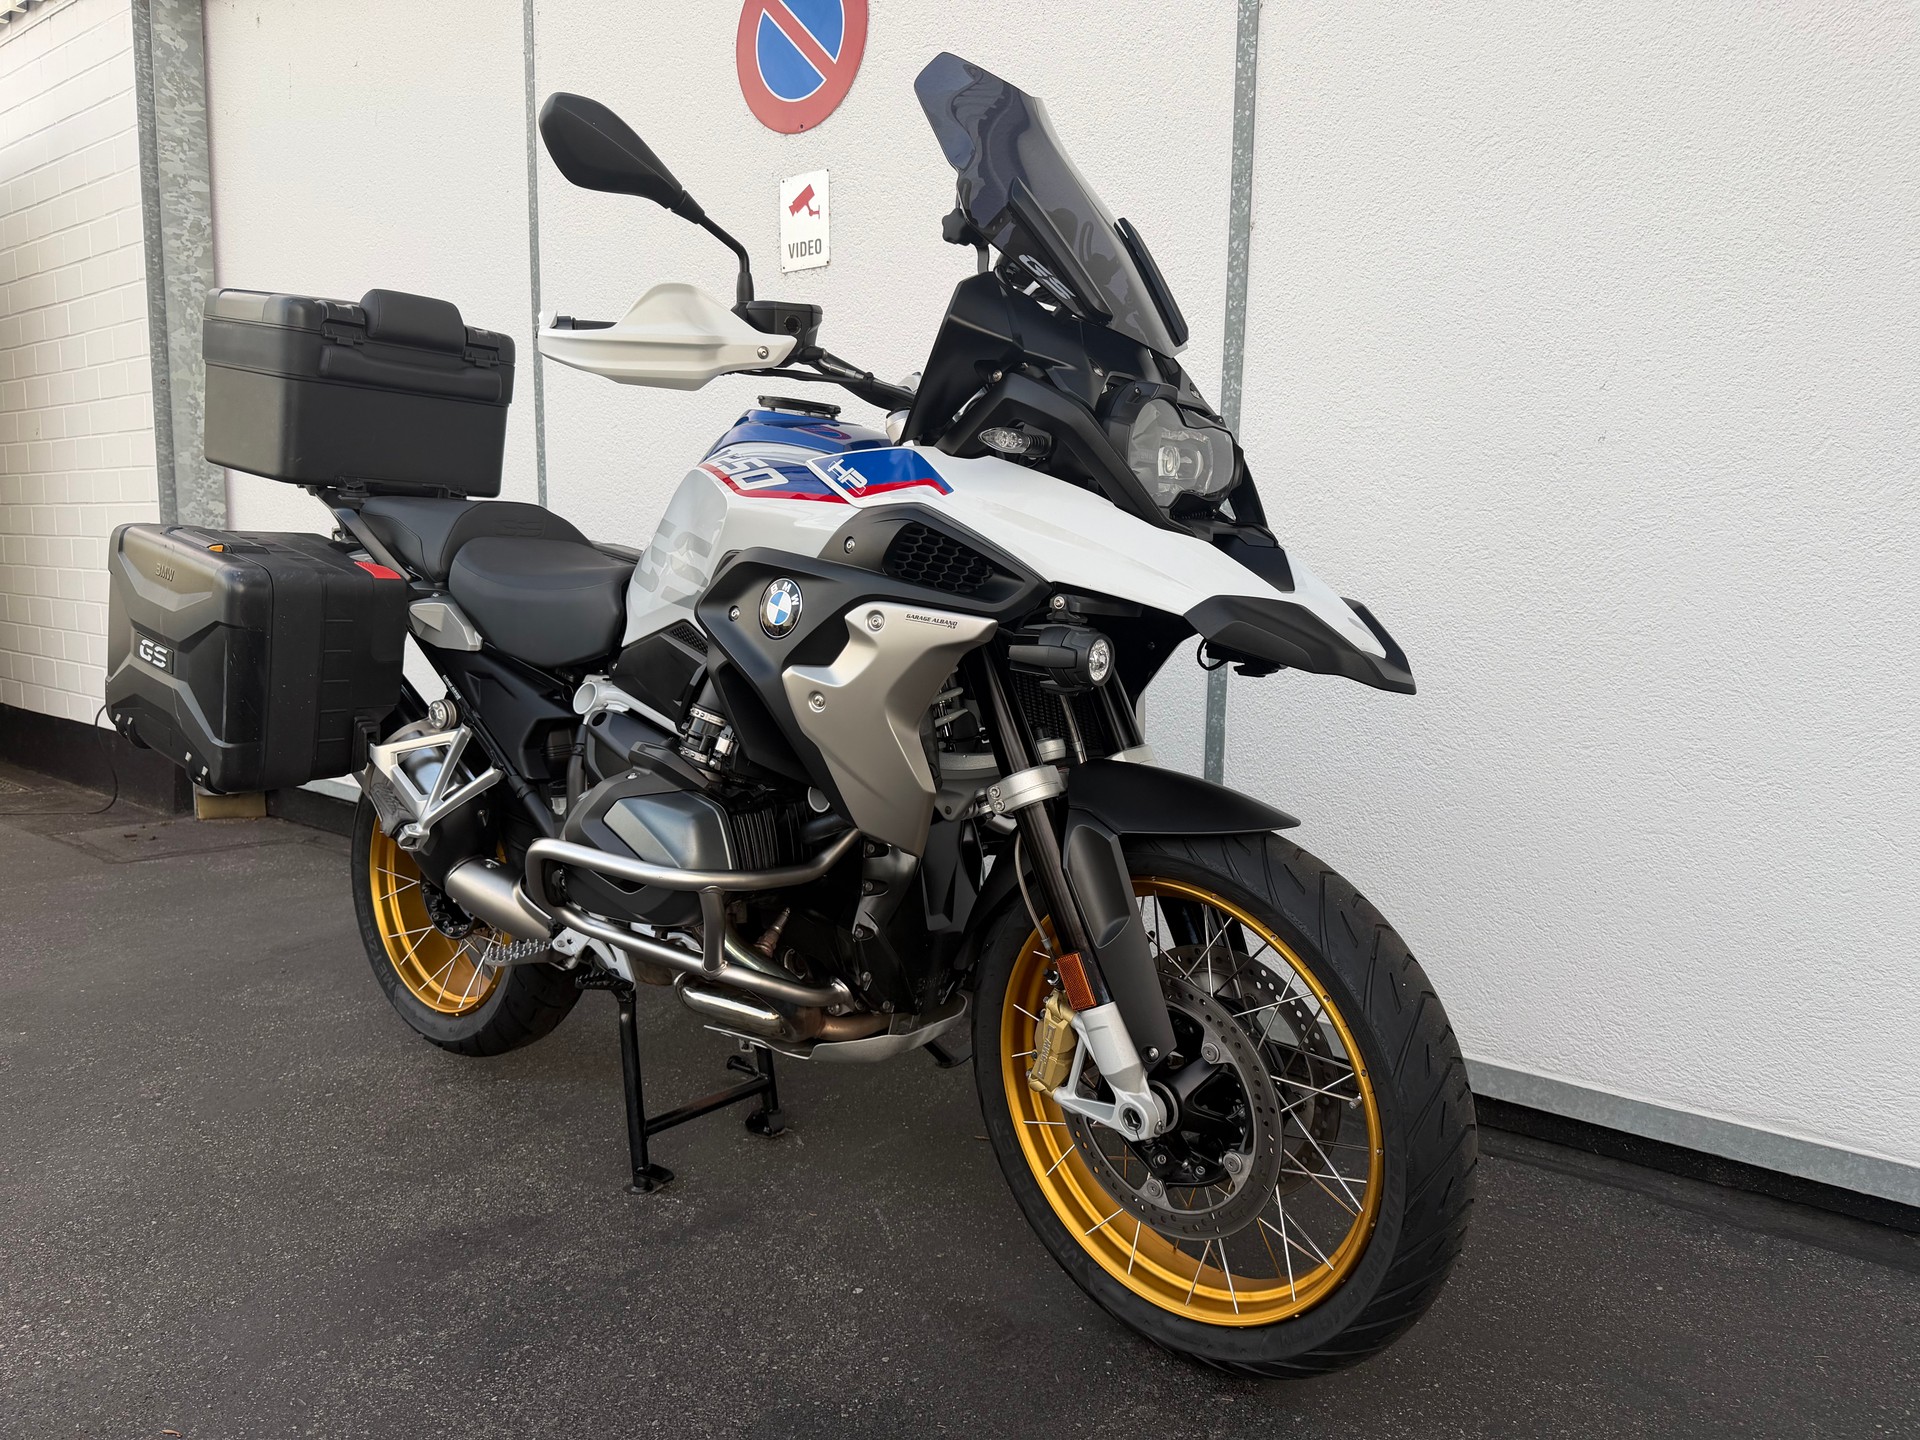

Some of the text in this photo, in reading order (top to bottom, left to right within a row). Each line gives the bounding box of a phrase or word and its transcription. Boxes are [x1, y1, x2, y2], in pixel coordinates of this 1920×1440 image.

[788, 238, 822, 259] VIDEO
[1018, 254, 1077, 300] GS
[827, 458, 868, 496] HP
[153, 562, 176, 582] BMW
[770, 581, 800, 606] BMW
[905, 613, 958, 627] GARAGE ALBANO
[139, 639, 168, 668] GS
[354, 891, 396, 993] METZELER
[989, 1117, 1086, 1271] METZELER
